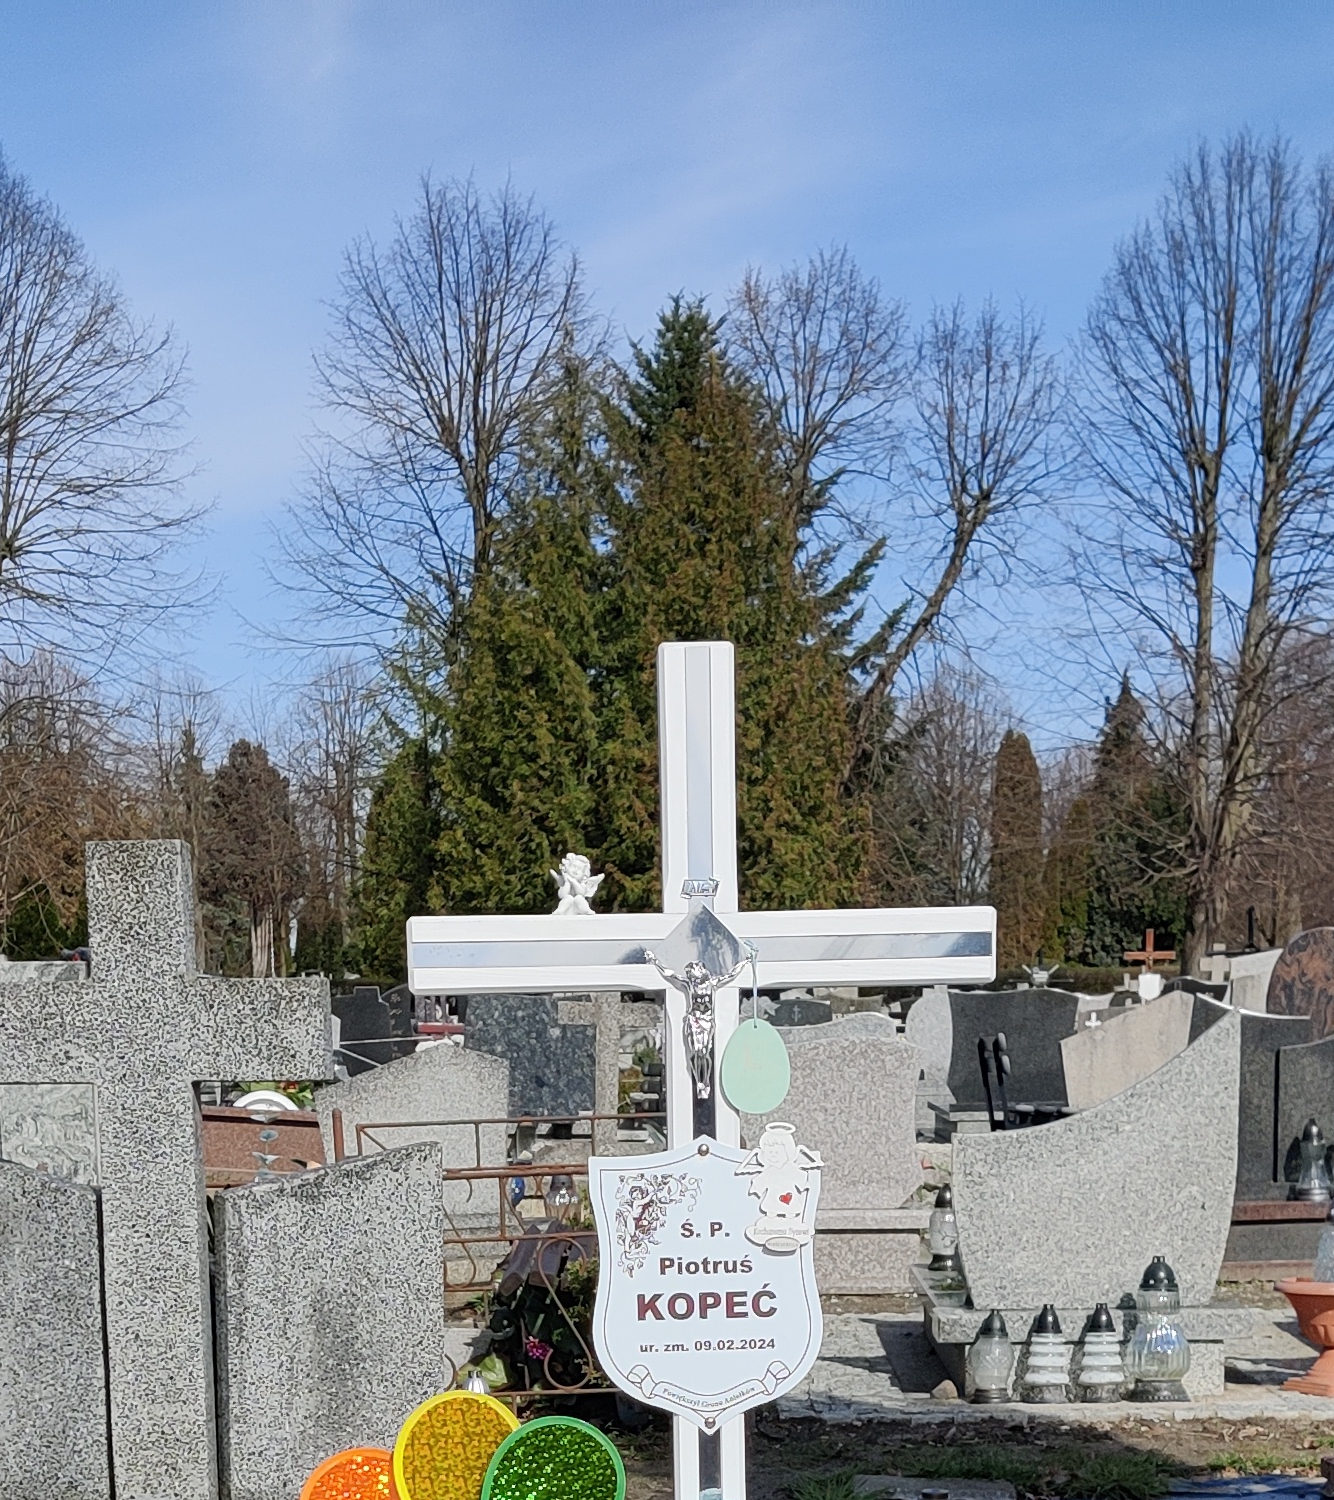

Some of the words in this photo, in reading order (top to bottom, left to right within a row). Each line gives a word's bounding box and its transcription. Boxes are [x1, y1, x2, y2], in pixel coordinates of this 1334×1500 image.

[680, 1218, 701, 1238] Ś.
[709, 1221, 730, 1238] P.
[659, 1254, 753, 1275] Piotruś
[636, 1283, 777, 1321] KOPEĆ
[639, 1344, 659, 1353] ur.
[663, 1343, 689, 1352] zm.
[694, 1338, 775, 1351] 09.02.2024
